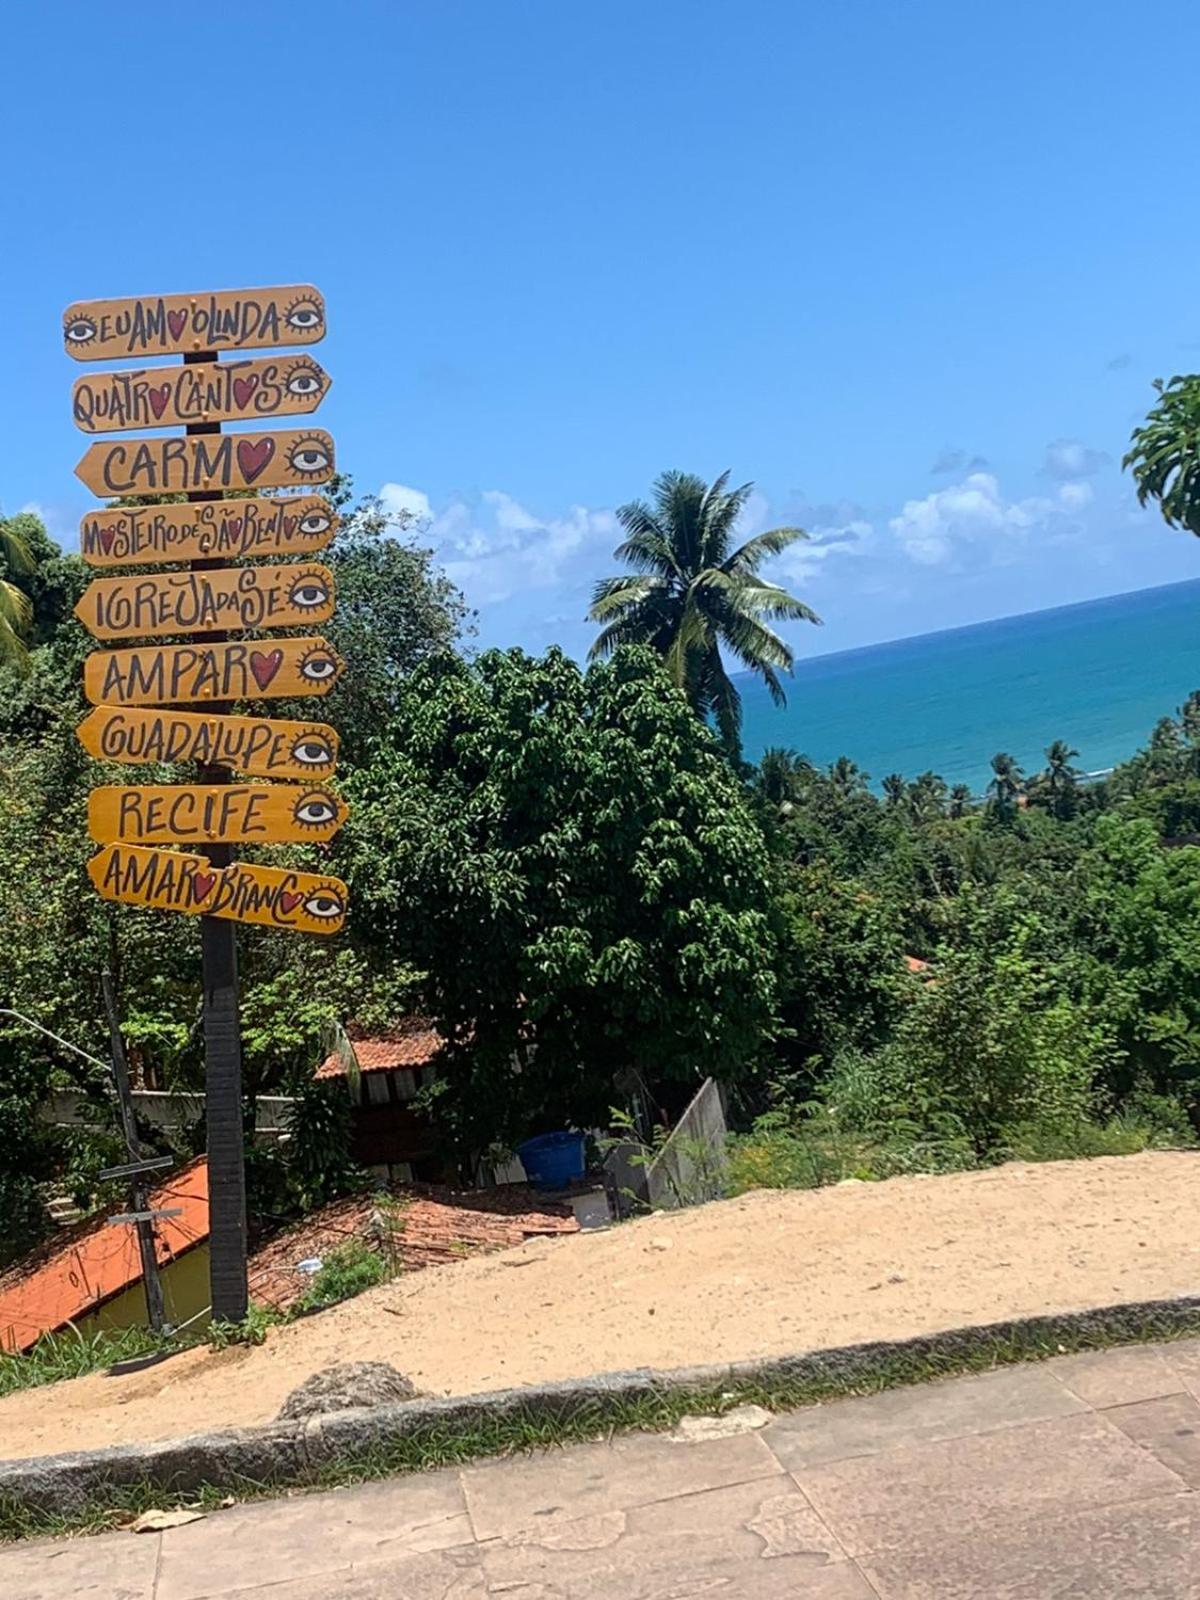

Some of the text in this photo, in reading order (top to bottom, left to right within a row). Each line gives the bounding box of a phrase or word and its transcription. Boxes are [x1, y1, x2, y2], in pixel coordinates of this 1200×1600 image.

[100, 310, 132, 343] EU
[192, 296, 282, 346] OLINDA
[177, 523, 200, 544] DE
[97, 569, 286, 630] IGREJA DA SÉ
[101, 715, 287, 770] GUADALUPE
[118, 789, 269, 838] RECIFE
